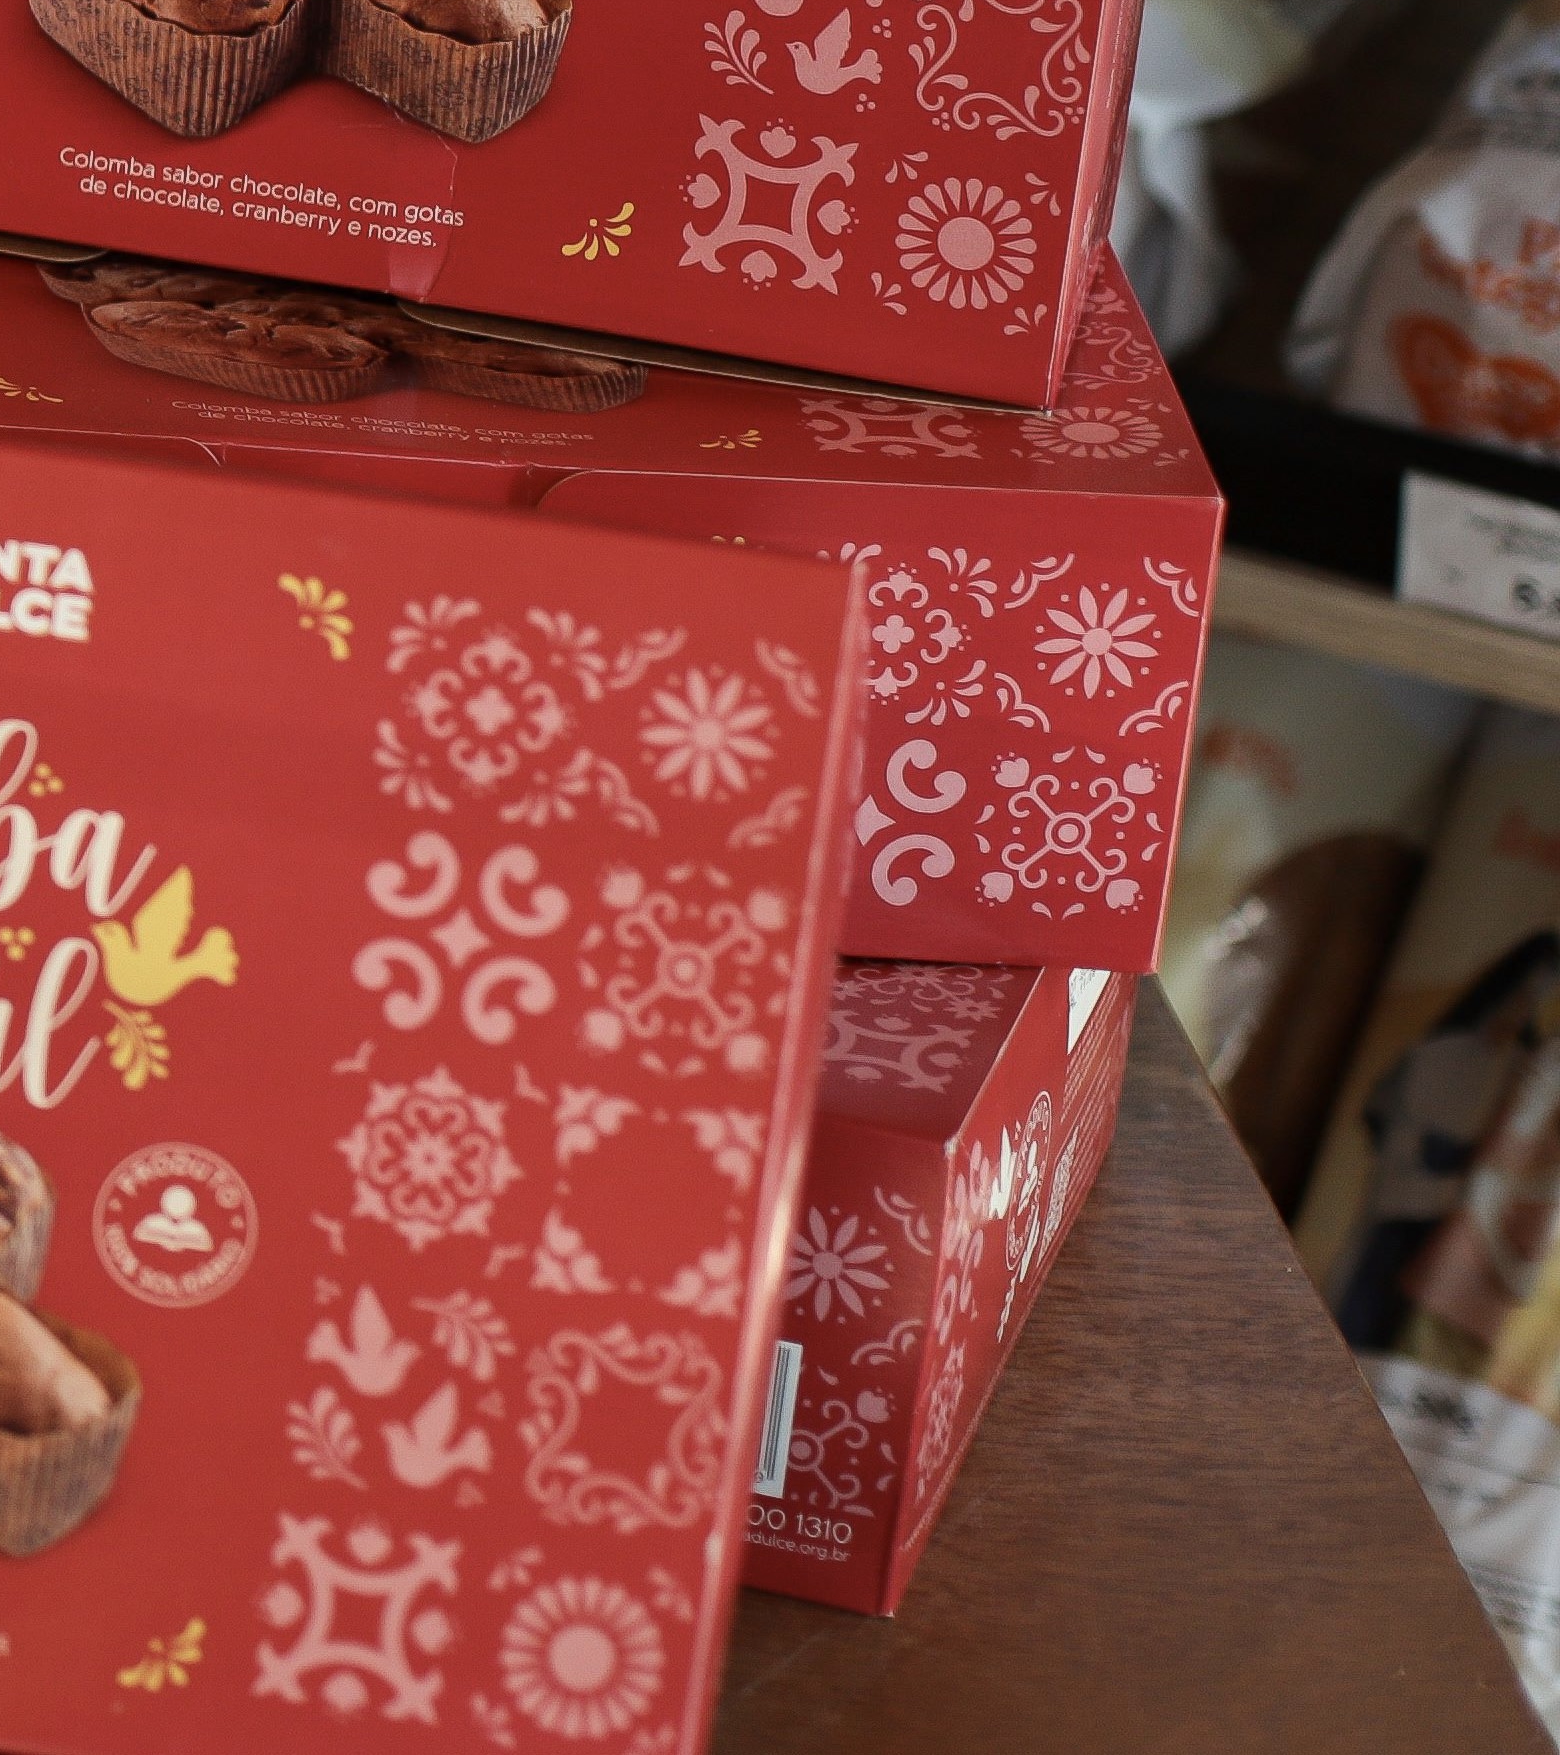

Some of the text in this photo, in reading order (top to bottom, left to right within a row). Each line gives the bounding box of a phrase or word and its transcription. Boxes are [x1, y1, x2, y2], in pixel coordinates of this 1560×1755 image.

[60, 147, 464, 228] Colomba sabor chocolate, com gotas
[80, 174, 437, 248] de chocolate, cranberry e nozes.
[171, 400, 594, 442] Colomba sabor chocolate, com gotas
[197, 409, 572, 447] de chocolate, cranberry e nozes.
[747, 1504, 852, 1544] 00 1310
[744, 1531, 851, 1562] adulce.org.br
